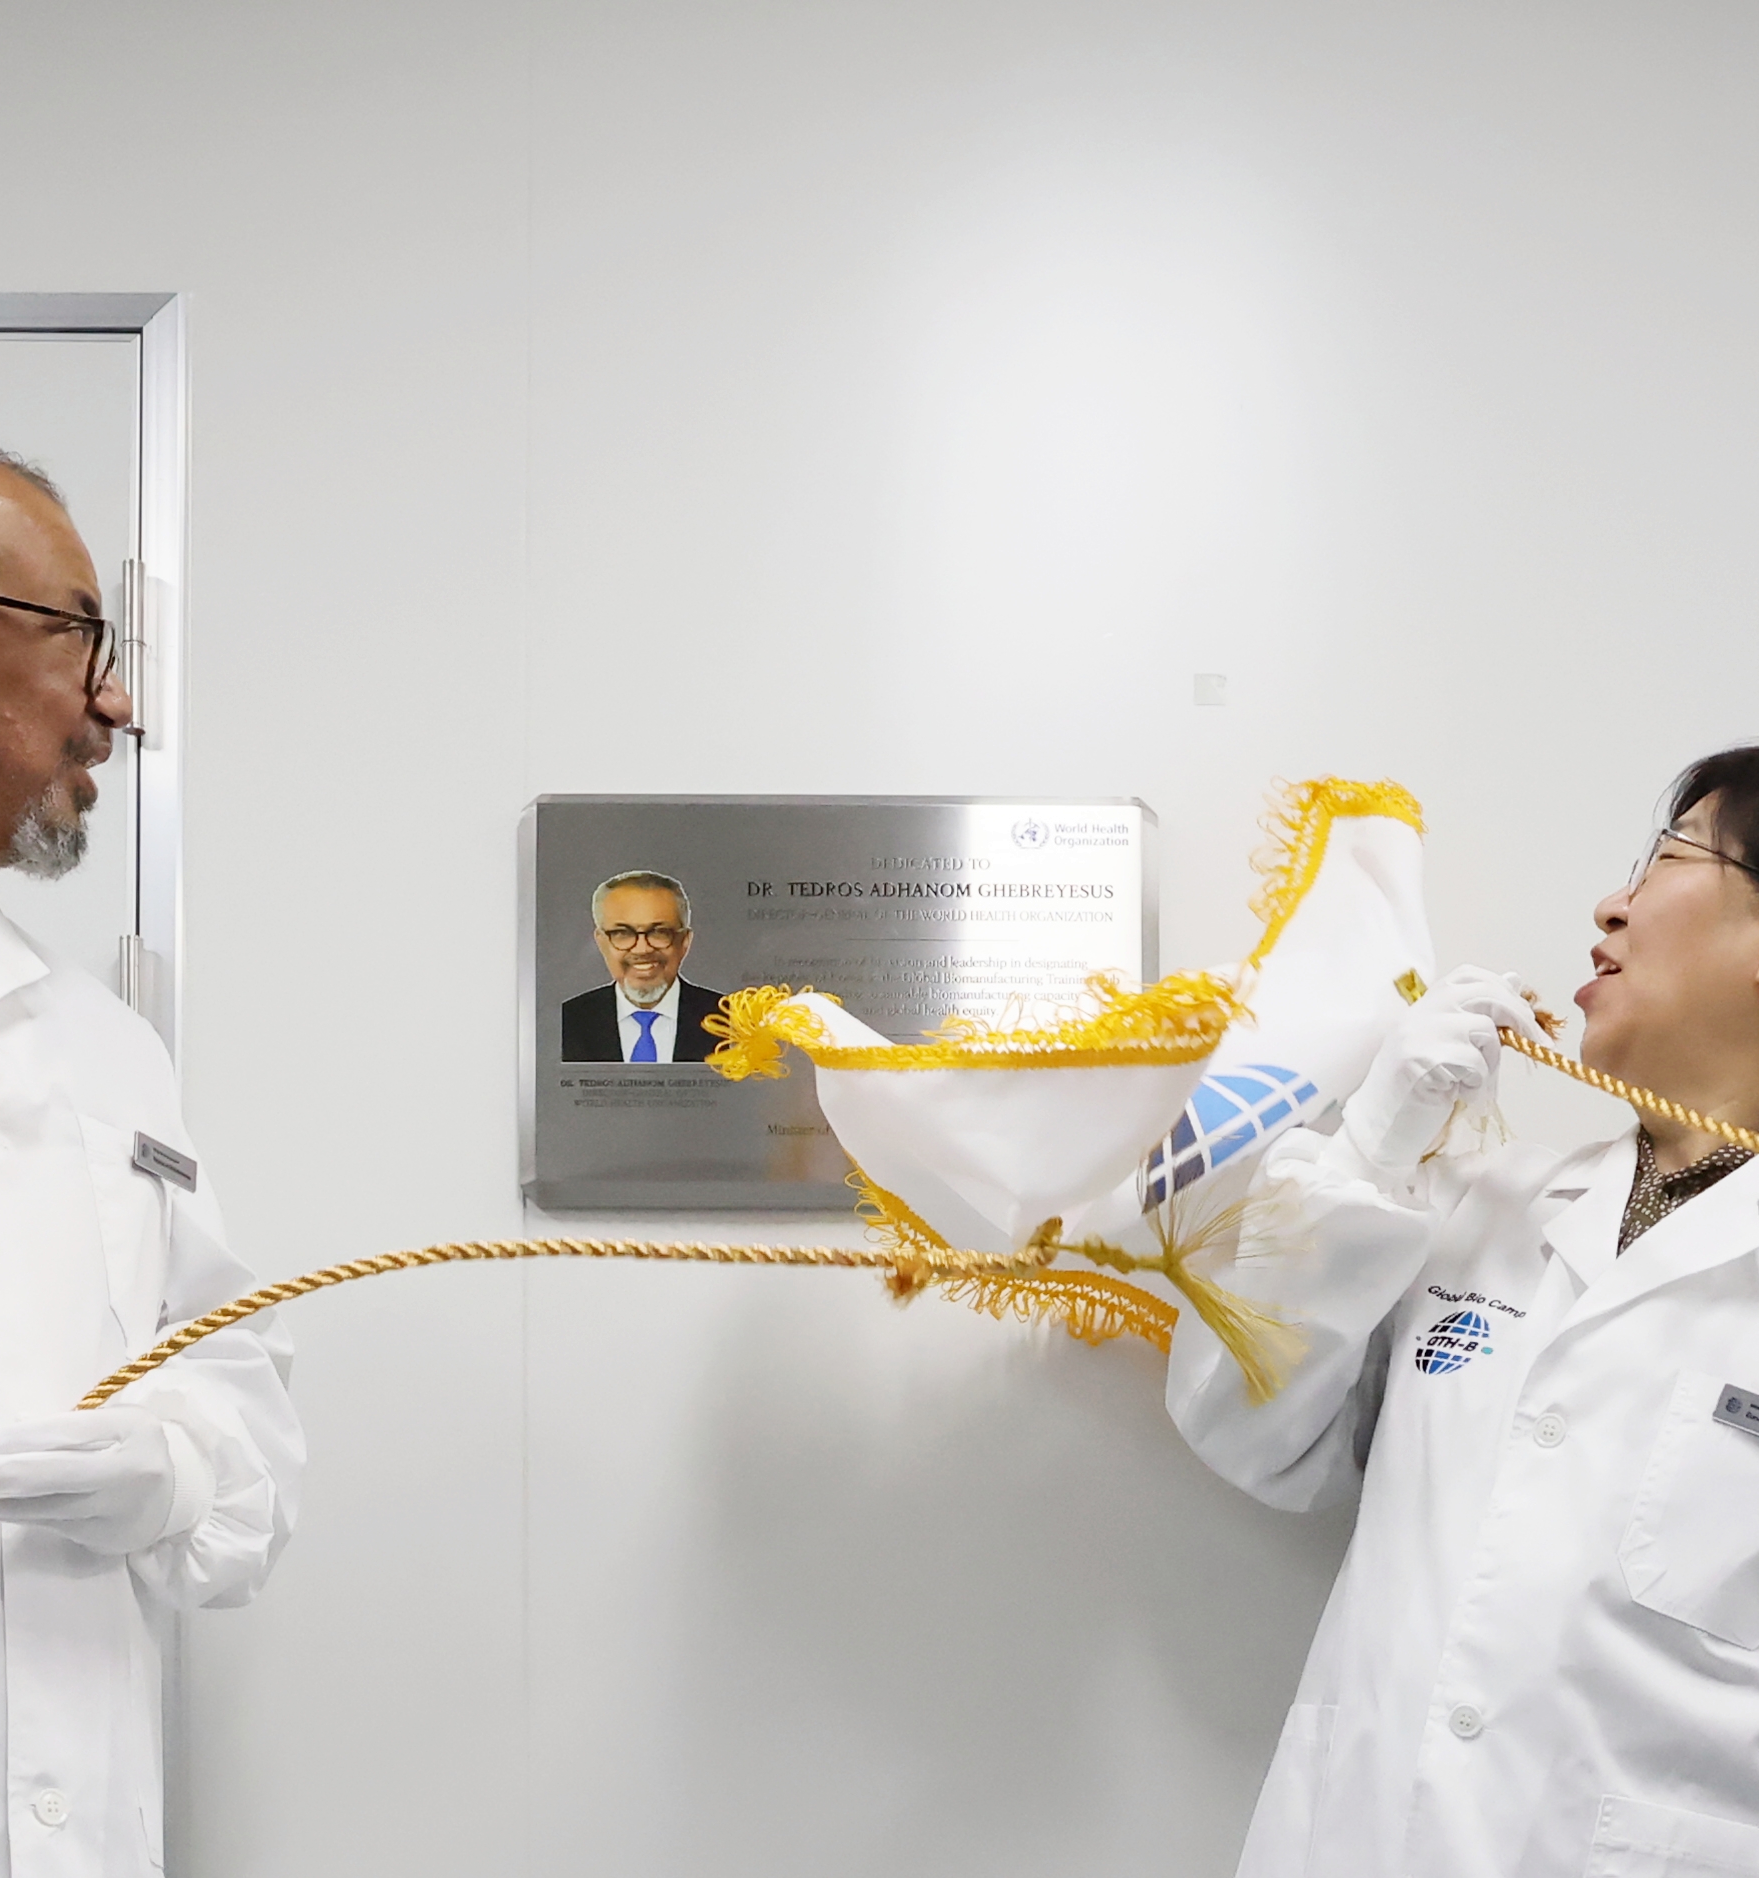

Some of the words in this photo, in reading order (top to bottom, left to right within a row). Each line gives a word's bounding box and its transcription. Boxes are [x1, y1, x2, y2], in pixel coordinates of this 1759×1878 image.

[1054, 823, 1088, 834] World
[1091, 823, 1129, 834] Health
[1054, 835, 1129, 848] Organization
[871, 857, 963, 870] DEDICATED
[969, 858, 991, 870] TO
[787, 881, 864, 898] TEDROS
[869, 882, 972, 899] ADHANOM
[977, 883, 1114, 899] GHEBREYESUS
[894, 909, 918, 921] THE
[919, 910, 967, 922] WORLD
[970, 911, 1016, 922] HEALTH
[1019, 911, 1113, 923] ORGANIZATION
[924, 955, 946, 968] and
[949, 955, 1007, 970] leadership
[1010, 956, 1021, 968] in
[1024, 957, 1089, 970] designating
[902, 972, 941, 985] Global
[942, 972, 1043, 986] Biomanufacturing
[1046, 973, 1094, 986] Trainin
[1034, 989, 1080, 1002] capacity
[922, 1003, 959, 1016] health
[1464, 1292, 1486, 1304] Bio
[1426, 1336, 1479, 1352] GTH-B
